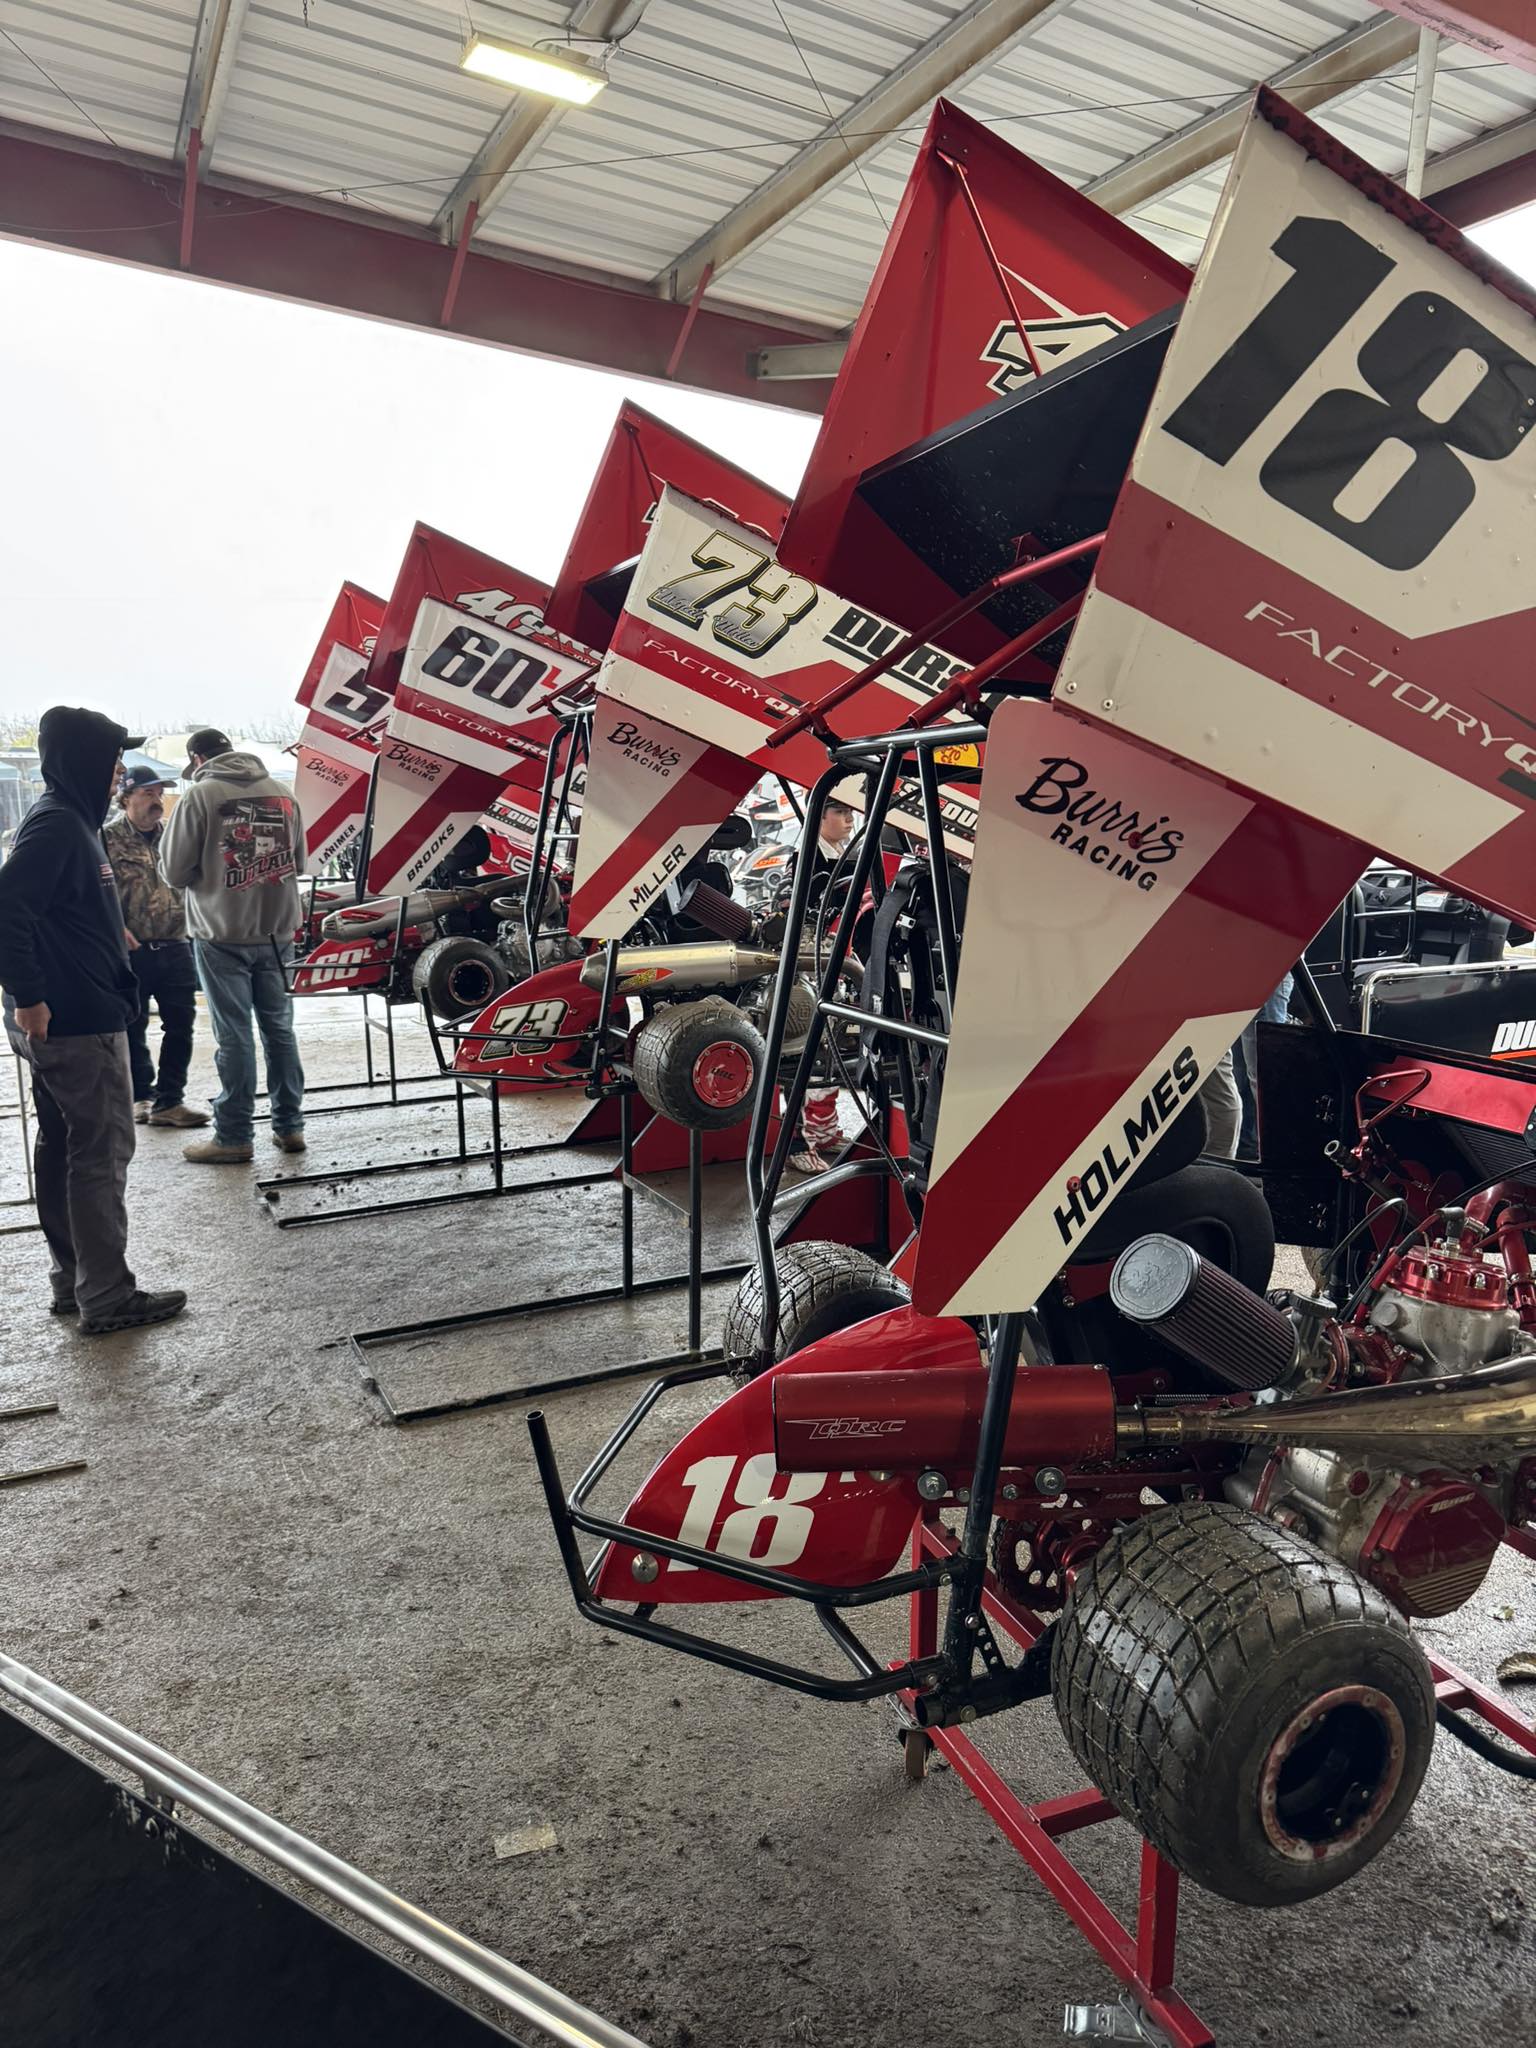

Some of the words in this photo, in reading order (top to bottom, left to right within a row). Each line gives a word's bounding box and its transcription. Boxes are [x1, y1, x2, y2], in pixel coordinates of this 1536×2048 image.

[1161, 216, 1536, 571] 18
[647, 529, 818, 659] 73
[644, 639, 769, 699] FACTORY
[1243, 601, 1514, 748] FACTORY
[416, 702, 508, 739] FACTORY
[606, 721, 681, 766] Burris
[305, 757, 351, 782] Burris
[315, 771, 345, 788] RACING
[386, 744, 443, 774] Burris
[398, 761, 435, 782] RACING
[622, 747, 670, 777] RACING
[1015, 757, 1184, 864] Burris
[225, 849, 295, 889] OUTLAW
[318, 824, 356, 865] LARIMER
[407, 824, 455, 882] BROOKS
[1050, 822, 1158, 892] RACING
[628, 843, 687, 912] MILLER
[478, 998, 571, 1062] 73
[1491, 1020, 1536, 1054] DU
[1053, 1045, 1200, 1246] HOLMES
[667, 1452, 828, 1573] 18
